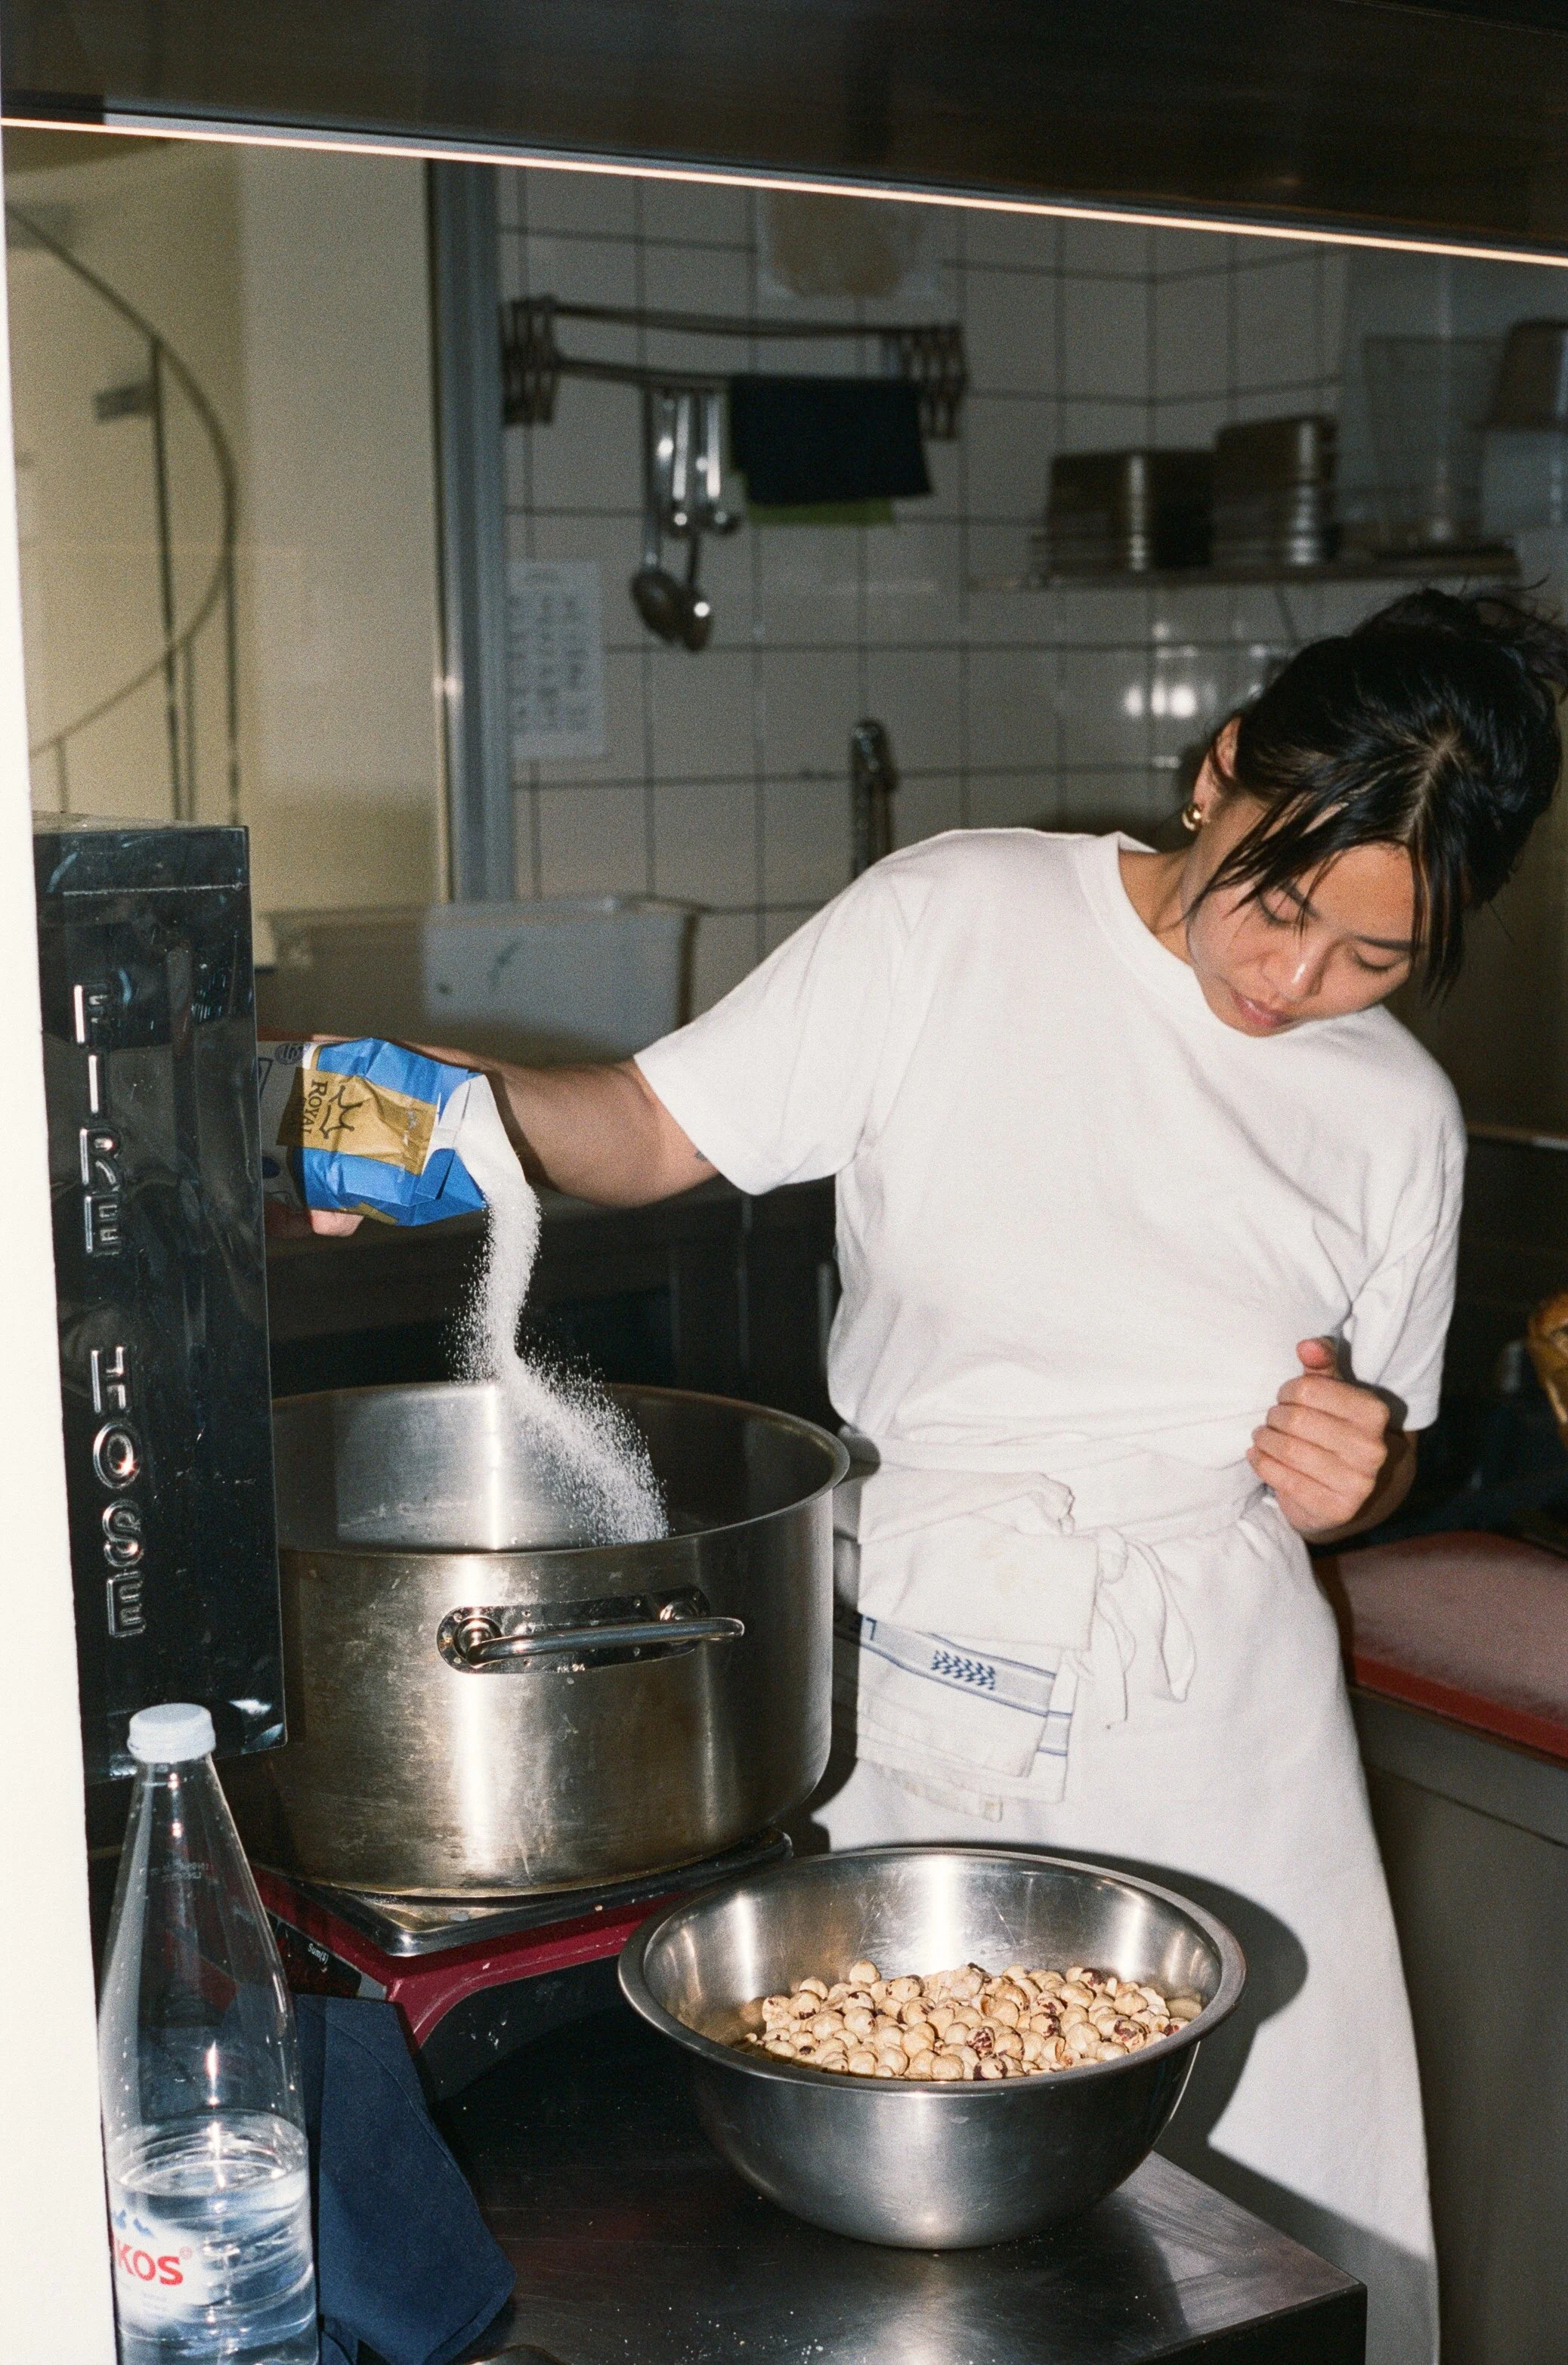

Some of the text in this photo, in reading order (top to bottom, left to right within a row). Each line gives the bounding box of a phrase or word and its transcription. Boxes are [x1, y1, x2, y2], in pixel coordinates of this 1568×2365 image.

[302, 1079, 328, 1136] ROYAL
[75, 983, 146, 1637] FIRE HOSE
